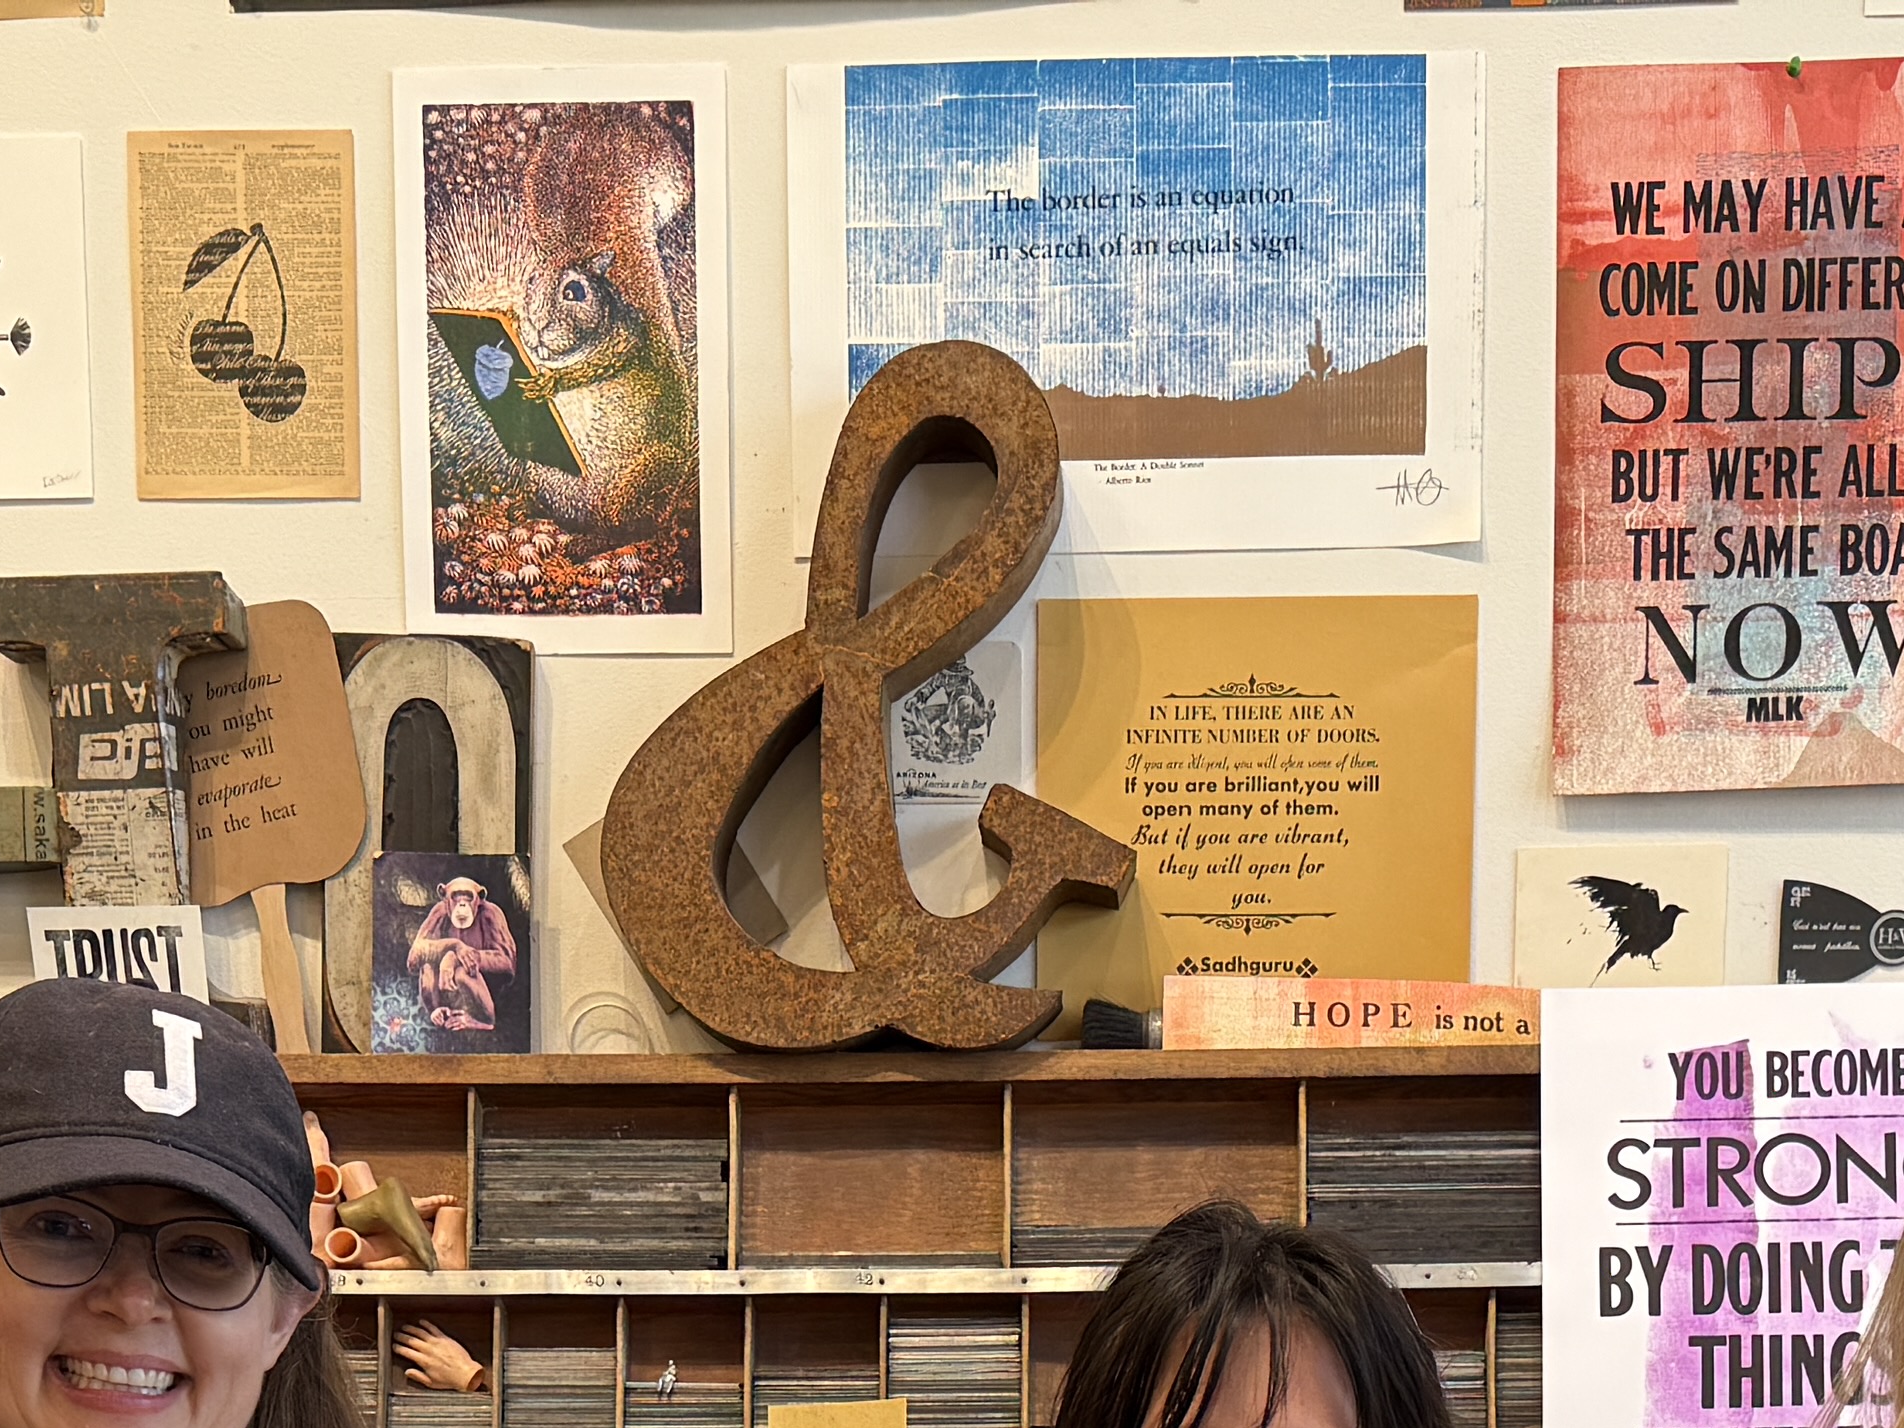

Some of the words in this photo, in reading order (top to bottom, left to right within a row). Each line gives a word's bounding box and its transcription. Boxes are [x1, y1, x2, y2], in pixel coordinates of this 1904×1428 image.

[986, 189, 1033, 213] The
[1041, 187, 1119, 213] border
[1129, 185, 1145, 209] is
[1155, 189, 1182, 207] an
[1190, 184, 1294, 213] equation
[206, 672, 282, 700] boredom
[1126, 729, 1201, 744] INFINITE
[1207, 729, 1279, 743] NUMBER
[1287, 729, 1310, 742] OF
[1318, 728, 1380, 743] DOORS.
[198, 774, 281, 808] evaporate
[196, 824, 212, 840] in
[224, 814, 250, 833] the
[261, 803, 297, 824] heat
[1142, 802, 1192, 820] open
[1199, 802, 1253, 819] many
[1260, 800, 1280, 816] of
[1285, 800, 1338, 816] them.
[1200, 957, 1294, 976] Sadhguru
[1292, 1001, 1413, 1029] HOPE
[1435, 1005, 1454, 1030] is
[1463, 1012, 1504, 1032] not
[1515, 1018, 1530, 1035] a
[124, 1009, 203, 1117] J
[1669, 1051, 1746, 1101] YOU
